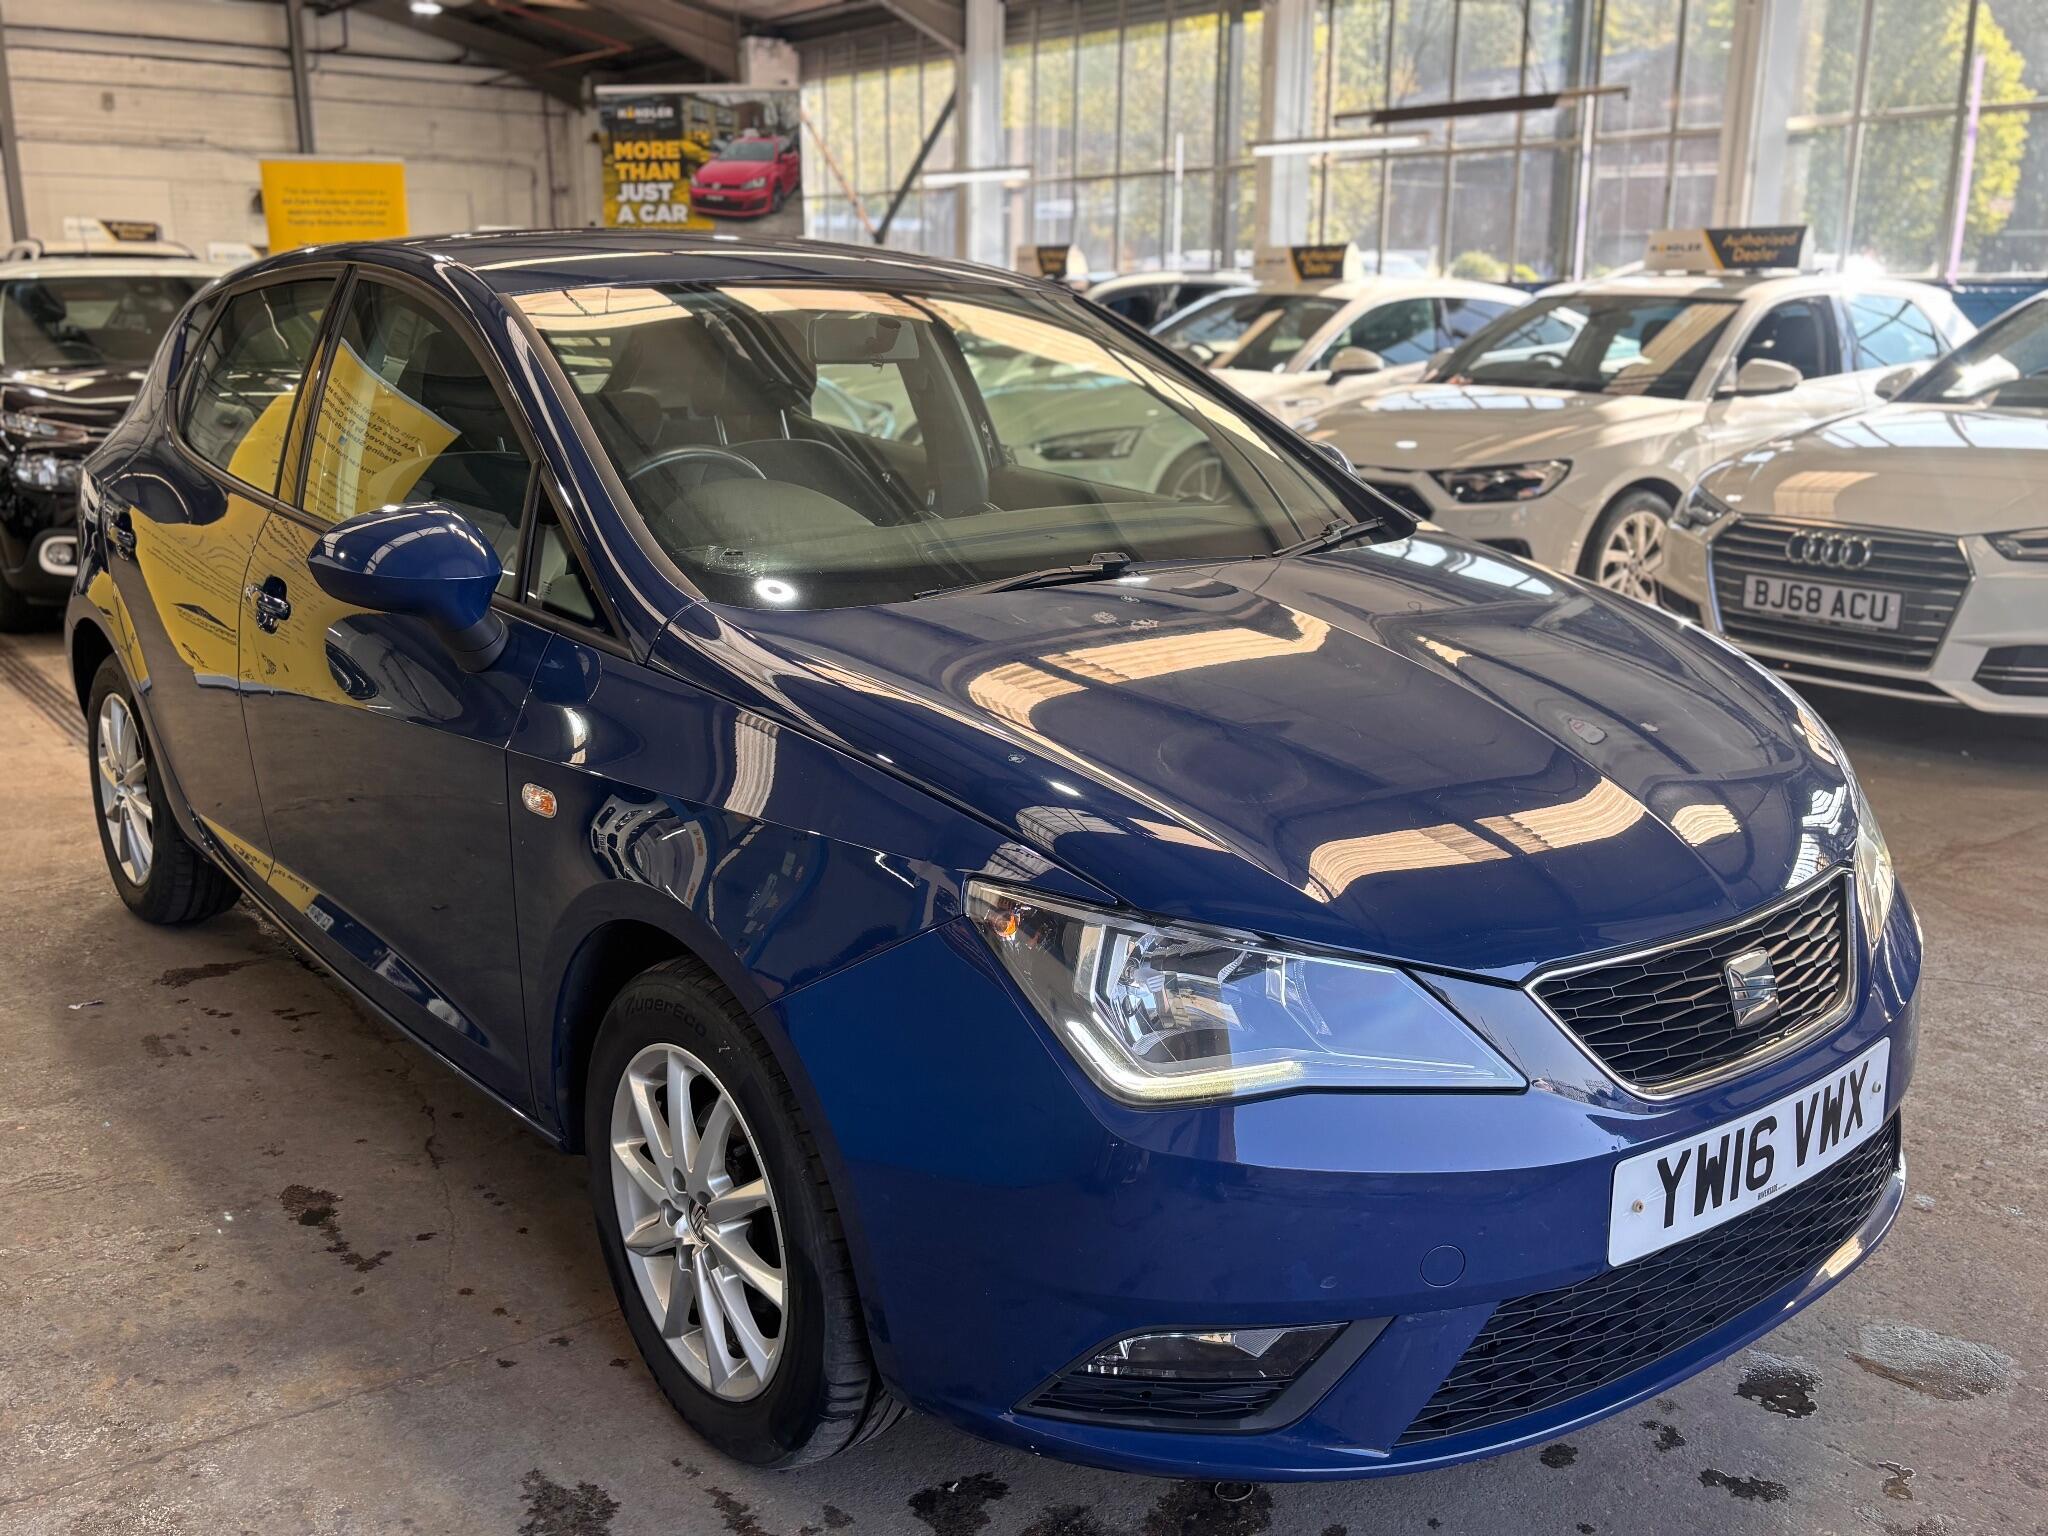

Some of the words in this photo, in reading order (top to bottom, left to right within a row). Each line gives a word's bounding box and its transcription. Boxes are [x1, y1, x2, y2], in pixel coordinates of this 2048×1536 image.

[613, 141, 681, 160] MORE
[614, 161, 681, 181] THAN
[616, 182, 674, 203] JUST
[617, 205, 636, 224] A
[639, 204, 689, 223] CAR
[1732, 247, 1779, 263] Dealer
[1753, 579, 1822, 614] BJ68
[1830, 590, 1889, 623] ACU
[1656, 1115, 1778, 1229] YW16
[1795, 1060, 1869, 1168] VWX
